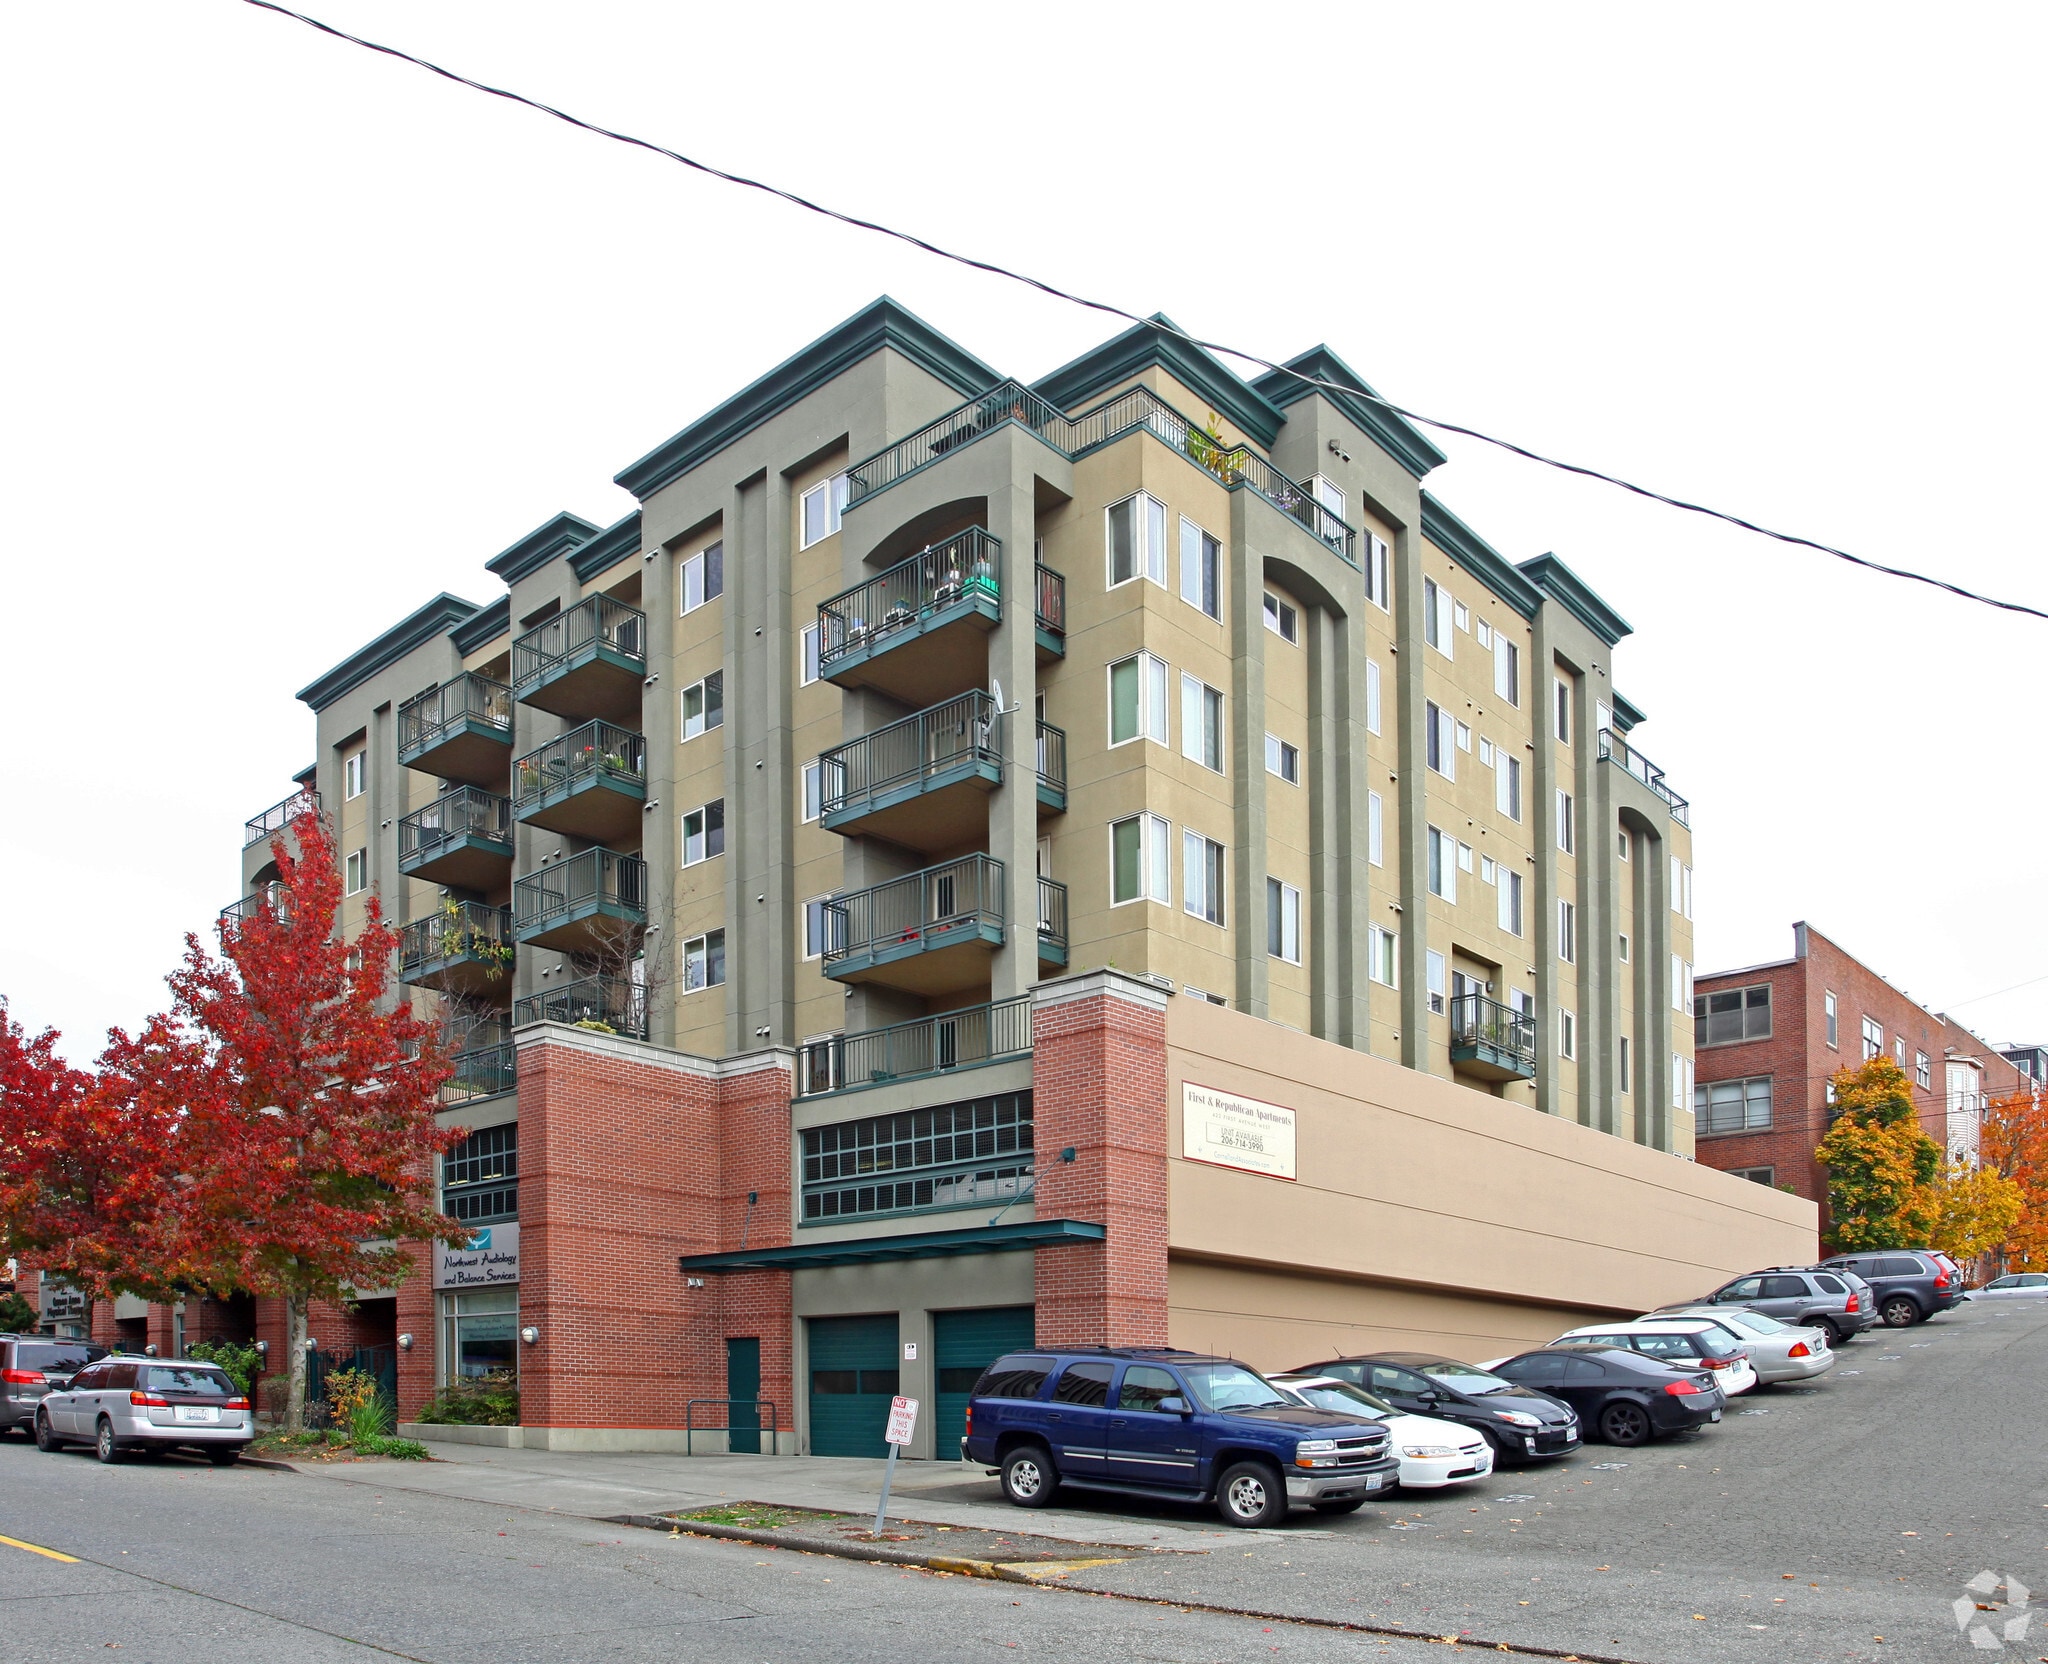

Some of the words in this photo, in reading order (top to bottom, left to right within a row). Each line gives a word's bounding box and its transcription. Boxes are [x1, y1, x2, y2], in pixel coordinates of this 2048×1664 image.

[1188, 1091, 1205, 1104] First
[1207, 1096, 1215, 1107] &
[1215, 1098, 1254, 1117] Republican
[1256, 1108, 1292, 1127] Apartments
[1221, 1127, 1234, 1138] UNIT
[1235, 1130, 1263, 1144] AVAILABLE
[444, 1256, 478, 1269] Northwest
[481, 1252, 517, 1266] Audiology
[444, 1274, 456, 1285] and
[457, 1271, 485, 1284] Balance
[486, 1268, 516, 1281] Services
[894, 1398, 905, 1407] NO
[893, 1410, 913, 1420] PARKING
[896, 1420, 908, 1429] THIS
[891, 1428, 908, 1438] SPACE
